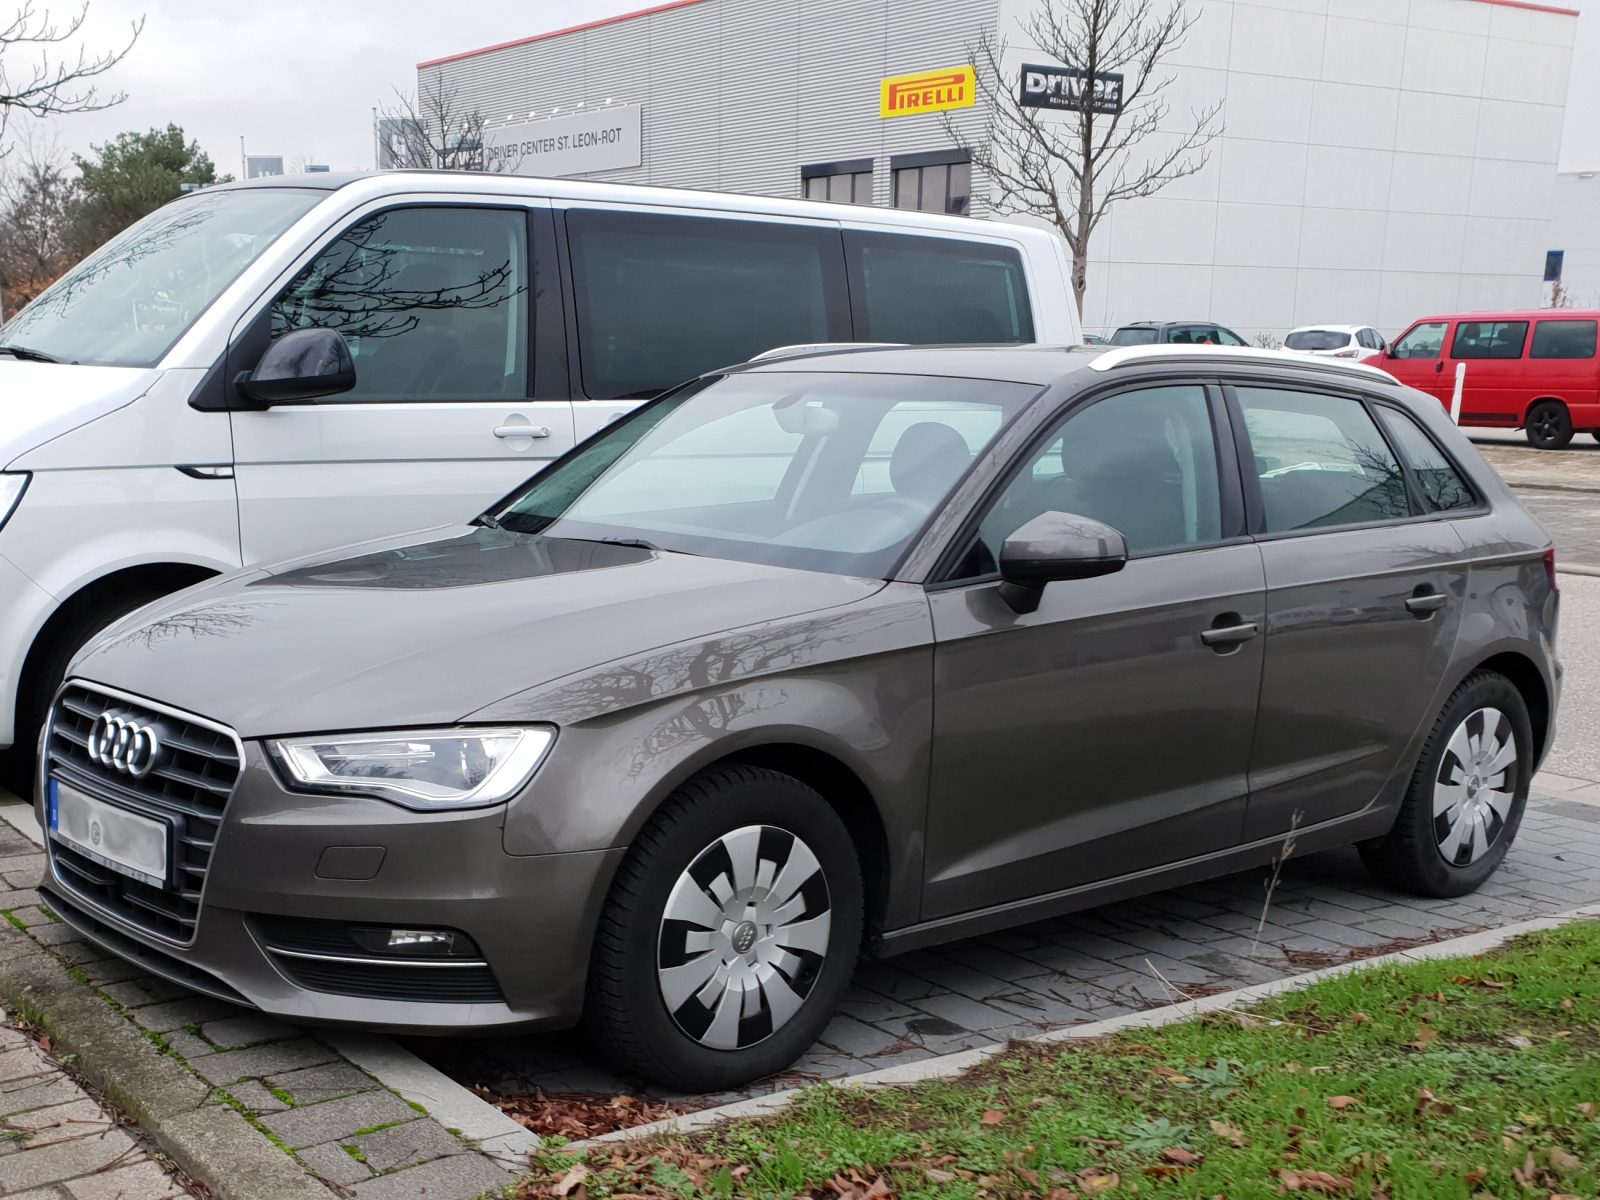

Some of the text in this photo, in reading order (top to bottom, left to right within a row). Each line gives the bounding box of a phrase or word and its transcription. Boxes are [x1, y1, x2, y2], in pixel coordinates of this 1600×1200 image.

[888, 73, 966, 111] PIRELLI
[488, 143, 518, 161] DRIVER
[520, 138, 555, 156] CENTER
[557, 136, 571, 151] ST.
[573, 128, 622, 149] LEON-ROT
